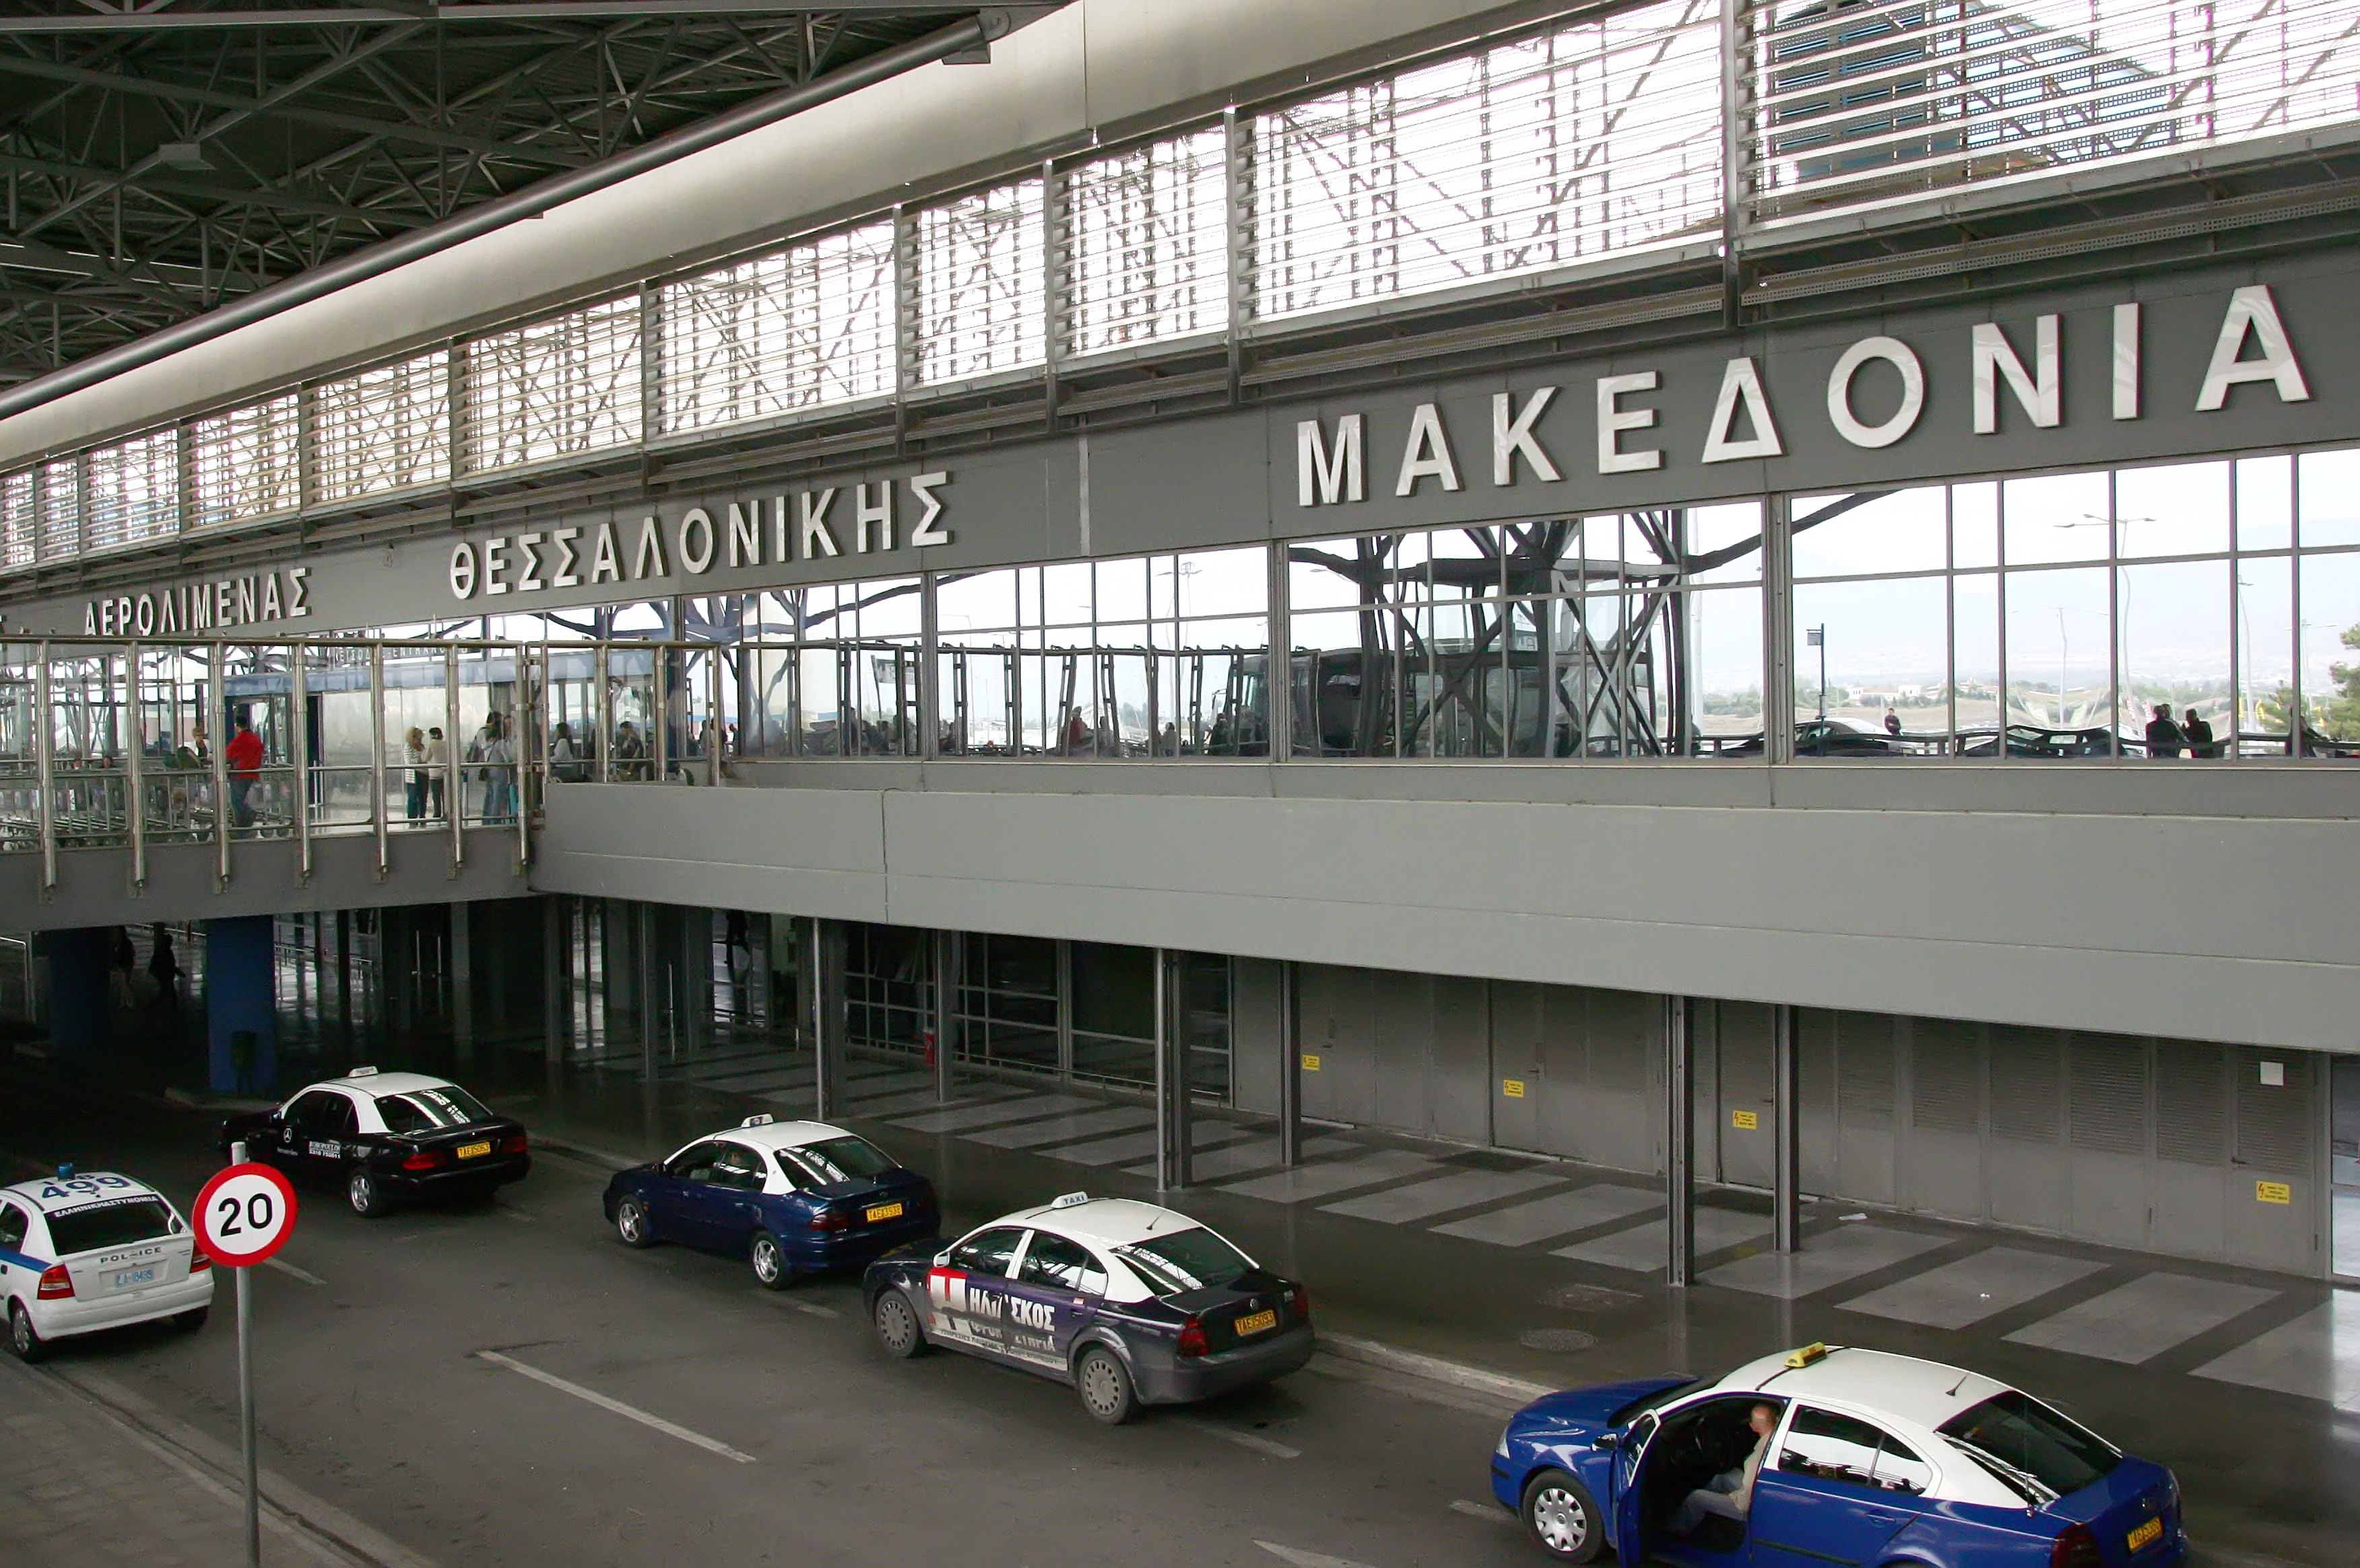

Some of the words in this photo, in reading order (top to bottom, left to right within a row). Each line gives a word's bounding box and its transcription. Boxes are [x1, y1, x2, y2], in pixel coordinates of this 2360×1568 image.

[1296, 284, 2311, 507] ΜΑΚΕΔΟΝΙΑ
[449, 471, 954, 599] ΘΕΣΣΑΛΟΝΙΚΗΣ
[85, 567, 311, 636] ΑΕΡΟΛΙΜΕΝΑΣ
[42, 1176, 131, 1198] 499
[218, 1193, 273, 1237] 20
[1063, 1194, 1084, 1205] TAXI
